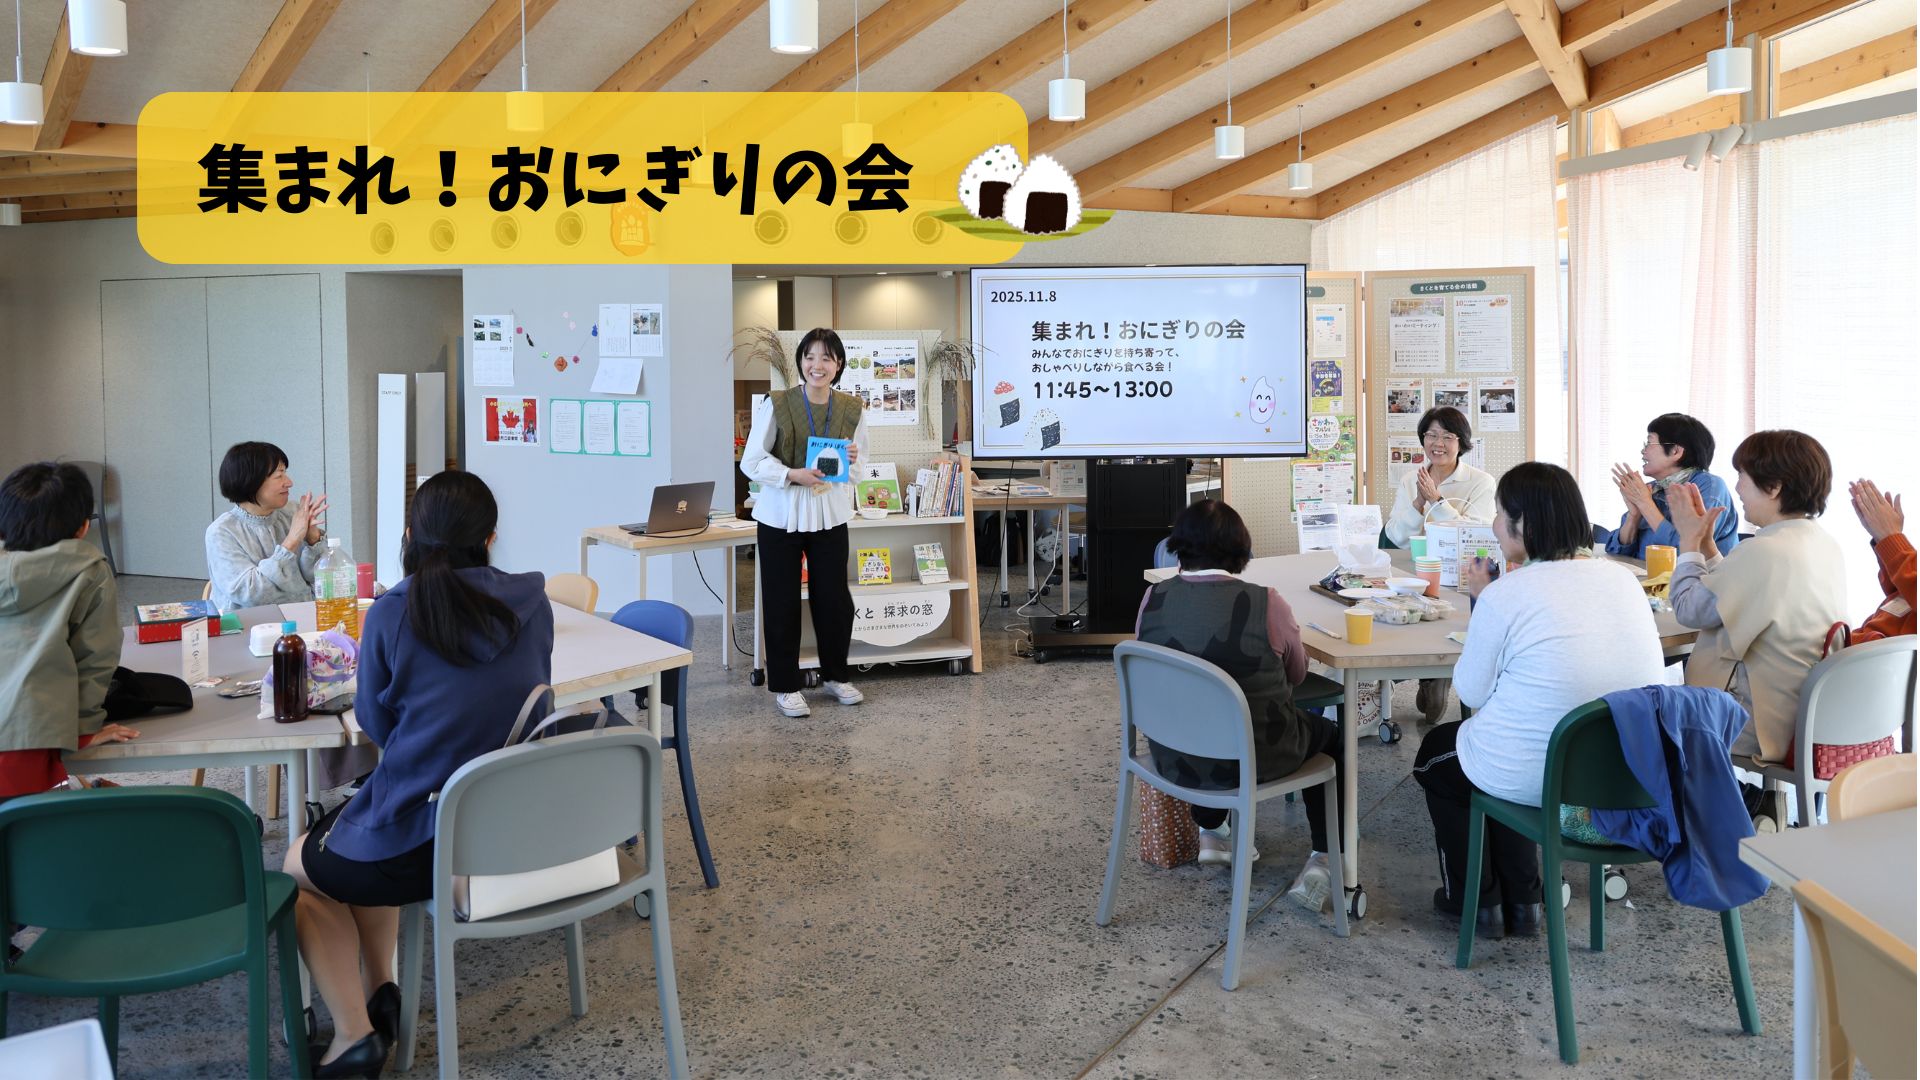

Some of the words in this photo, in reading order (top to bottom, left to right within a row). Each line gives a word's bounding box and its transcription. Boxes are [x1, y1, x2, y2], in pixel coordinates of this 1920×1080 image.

[990, 290, 1057, 303] 2025.11.8
[1031, 319, 1246, 342] 集まれ！おにぎりの会
[1031, 347, 1180, 359] みんなでおにぎりを持ち寄って、
[1031, 361, 1172, 374] おしゃべりしながら食べる会！
[870, 469, 880, 478] 米
[884, 603, 934, 618] 探求の窓
